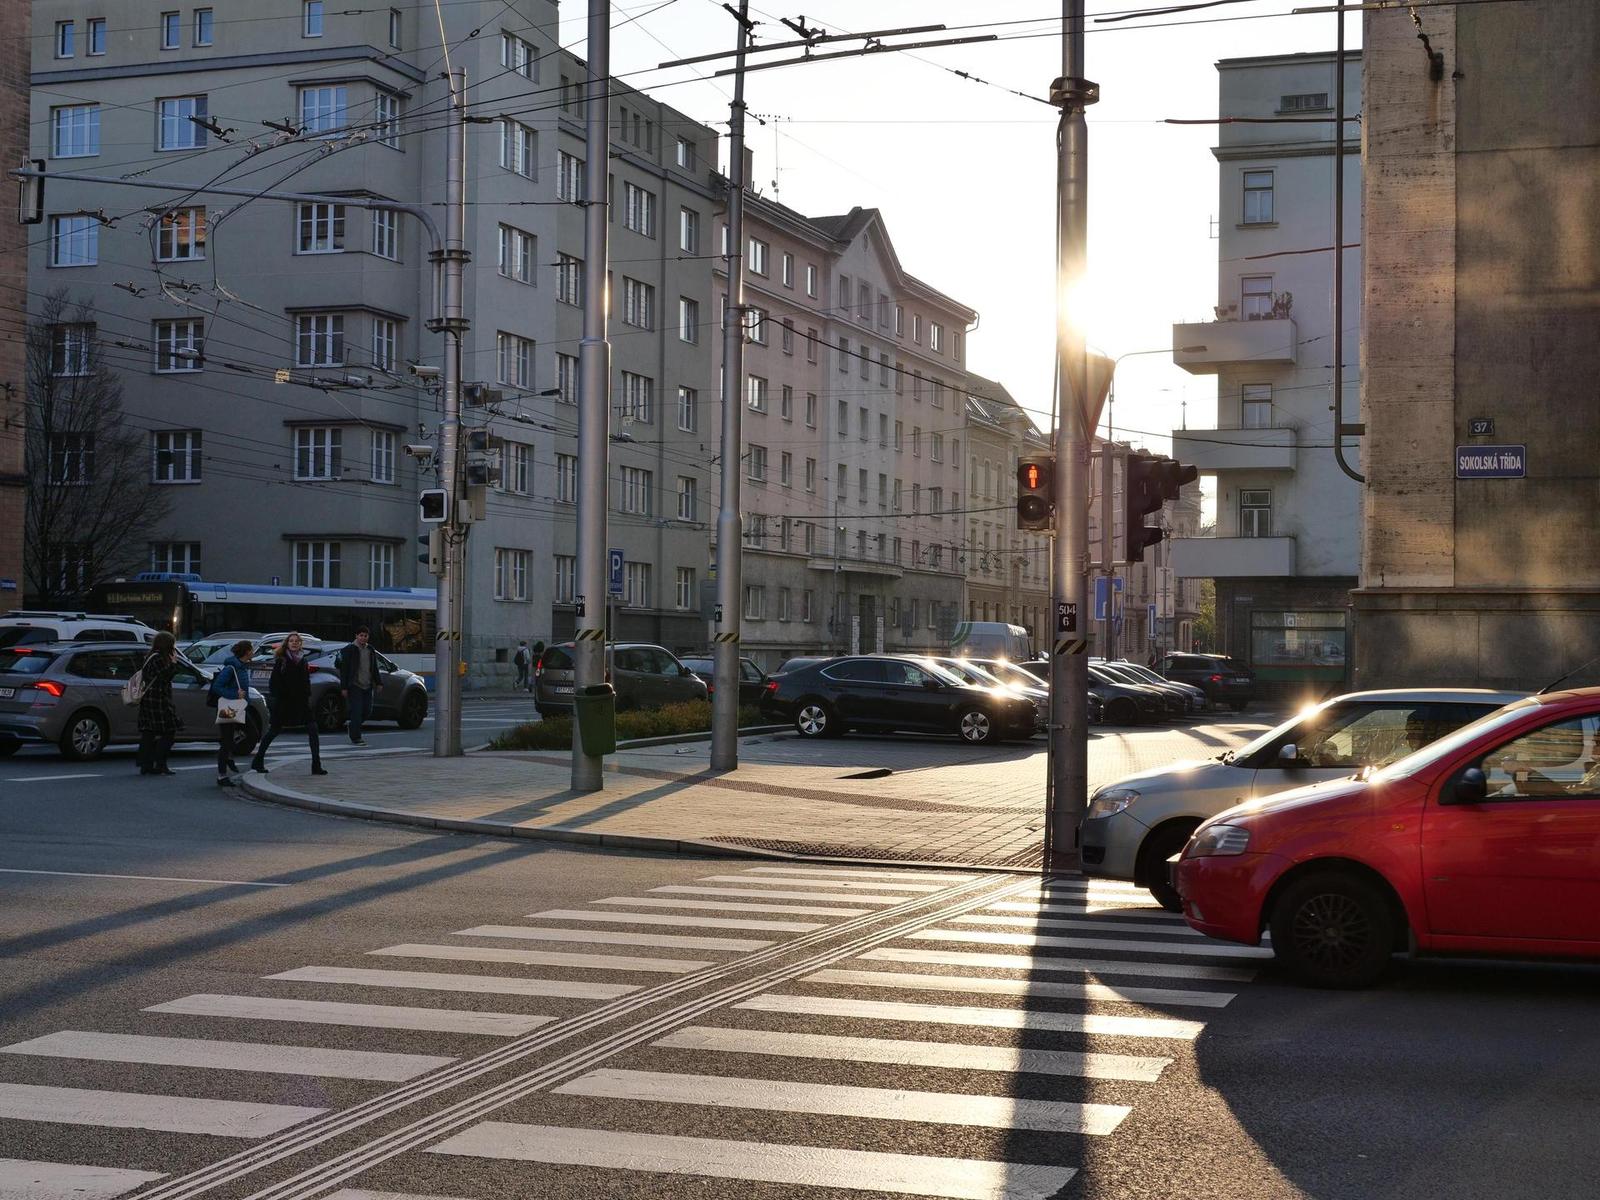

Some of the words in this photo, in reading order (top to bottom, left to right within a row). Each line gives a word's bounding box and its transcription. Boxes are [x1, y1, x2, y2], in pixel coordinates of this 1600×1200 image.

[1474, 422, 1488, 433] 37
[1459, 453, 1498, 470] SOKOLSKÁ
[1499, 452, 1522, 470] TŘÍDA
[612, 554, 621, 580] P
[1059, 605, 1076, 615] 504
[1062, 617, 1070, 627] 6
